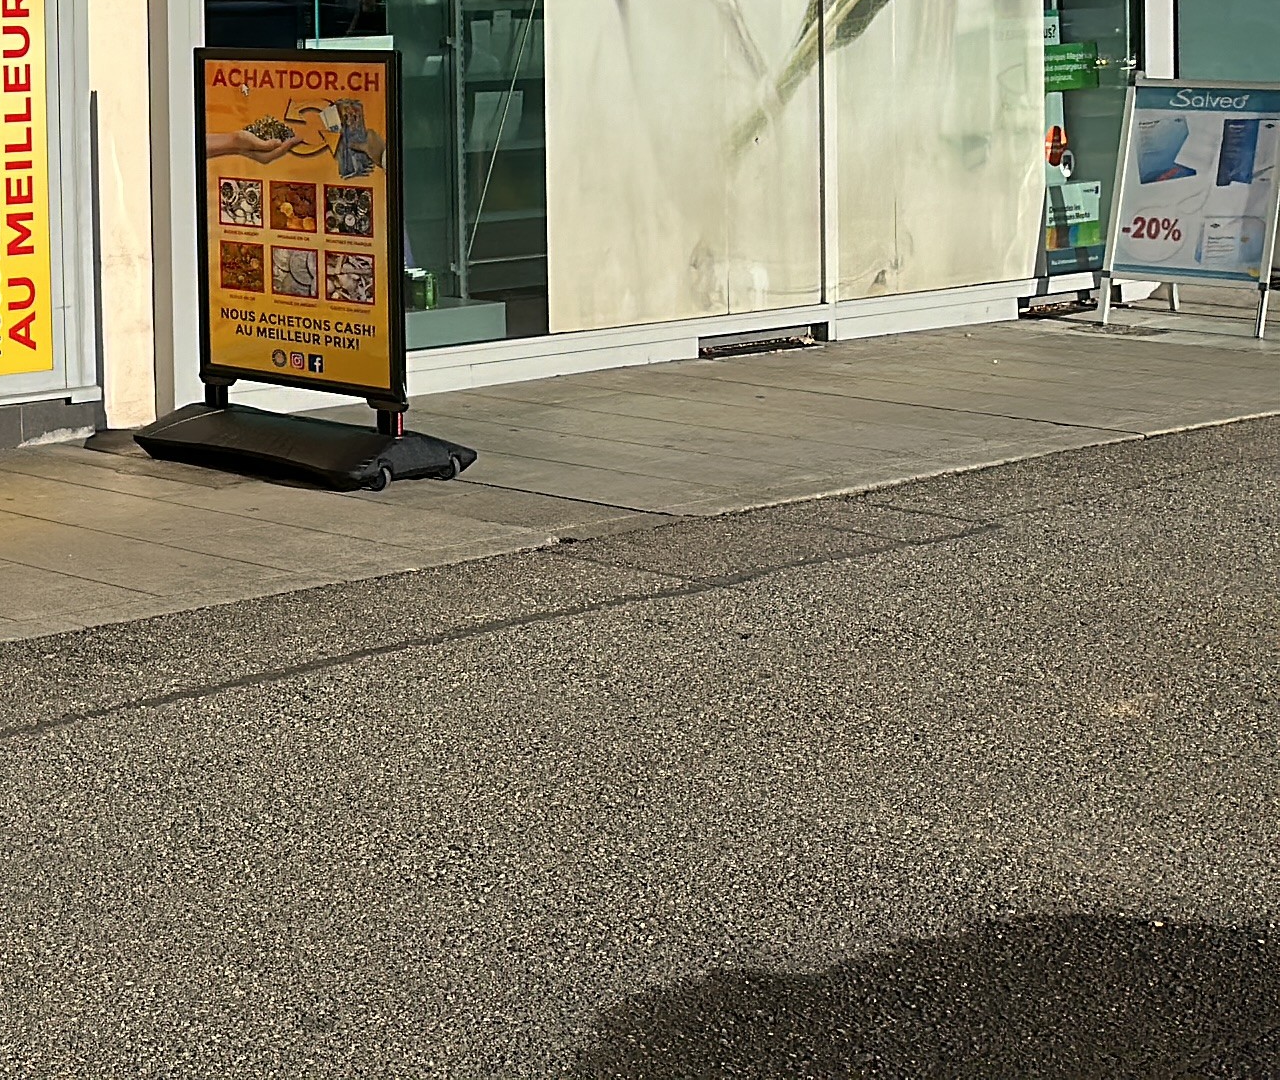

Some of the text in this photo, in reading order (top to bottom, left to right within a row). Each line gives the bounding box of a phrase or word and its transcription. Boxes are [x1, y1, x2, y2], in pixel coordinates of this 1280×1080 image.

[212, 68, 380, 92] ACHATDOR.CH
[1169, 88, 1250, 109] Salveo
[1121, 216, 1182, 242] -20%
[8, 277, 37, 351] AU
[220, 308, 376, 337] NOUS ACHETONS CASH!
[235, 324, 360, 351] AU MEILLEUR PRIX!
